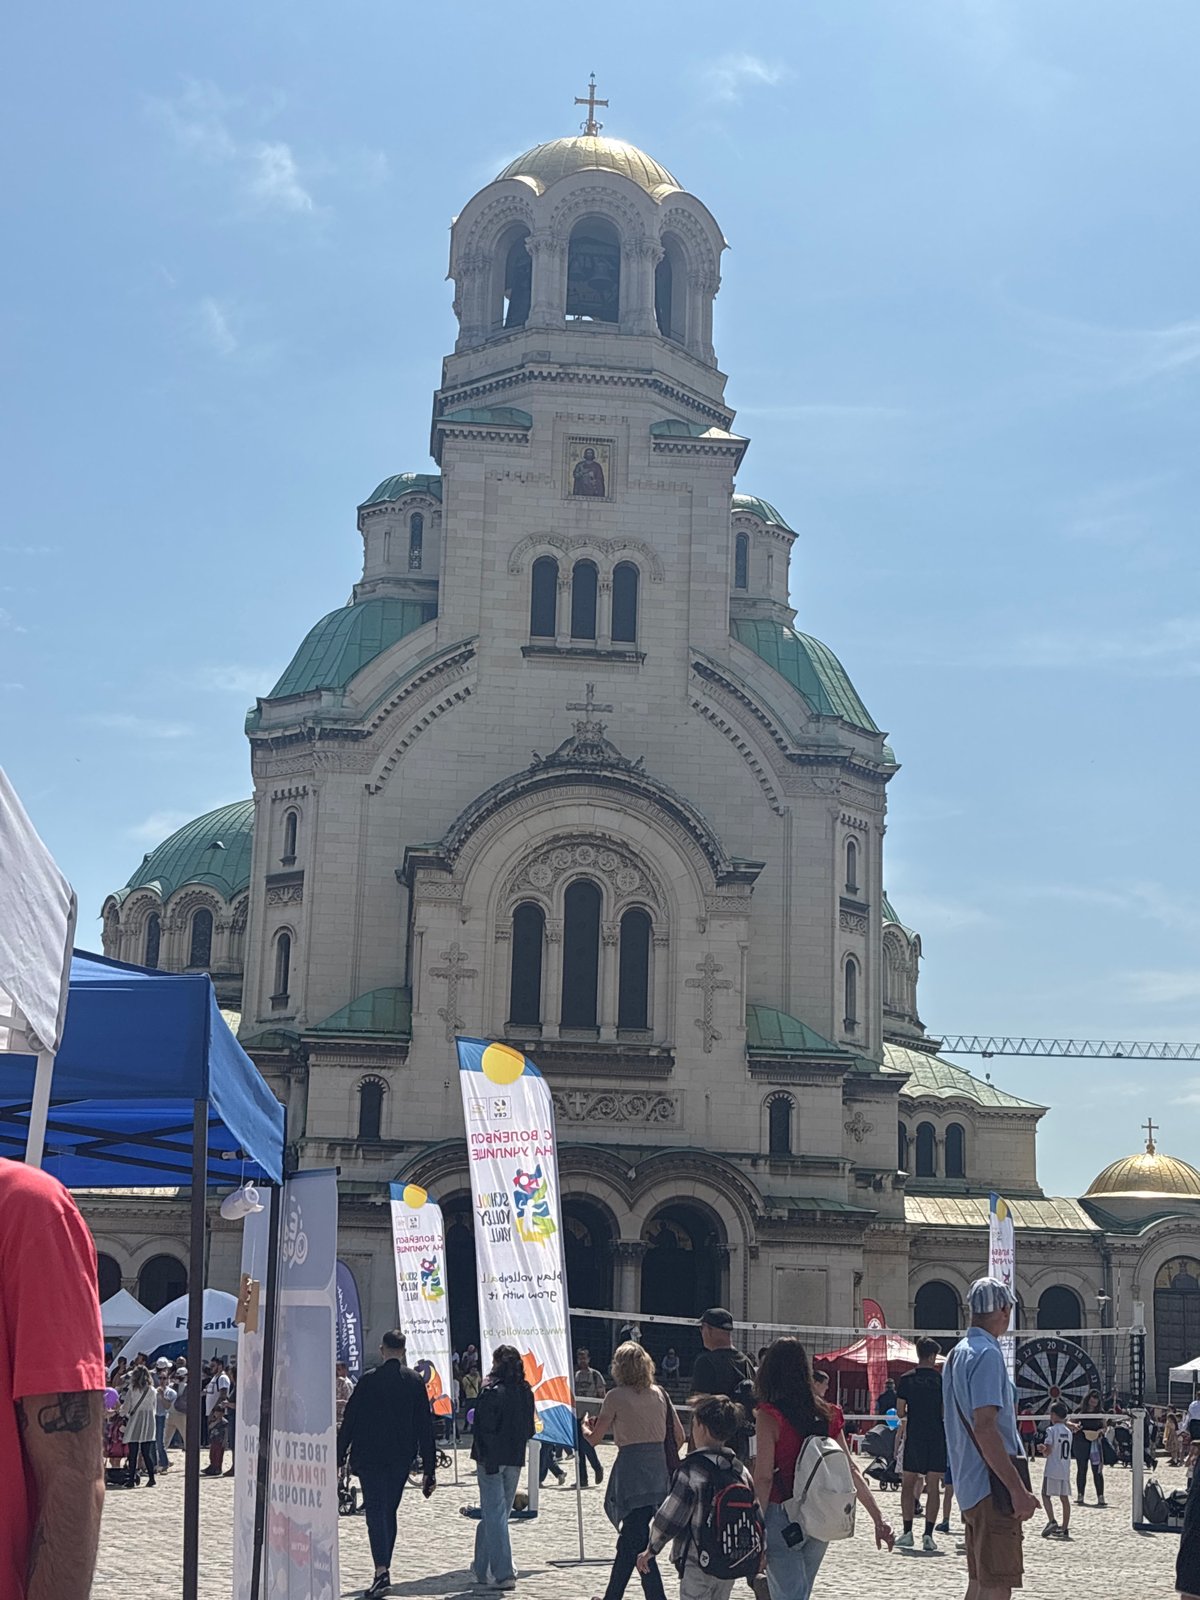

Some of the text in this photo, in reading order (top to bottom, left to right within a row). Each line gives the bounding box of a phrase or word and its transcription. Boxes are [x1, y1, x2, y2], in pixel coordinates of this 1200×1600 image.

[176, 1317, 238, 1331] Fiank
[1023, 1349, 1032, 1358] 12
[1047, 1341, 1057, 1350] 20
